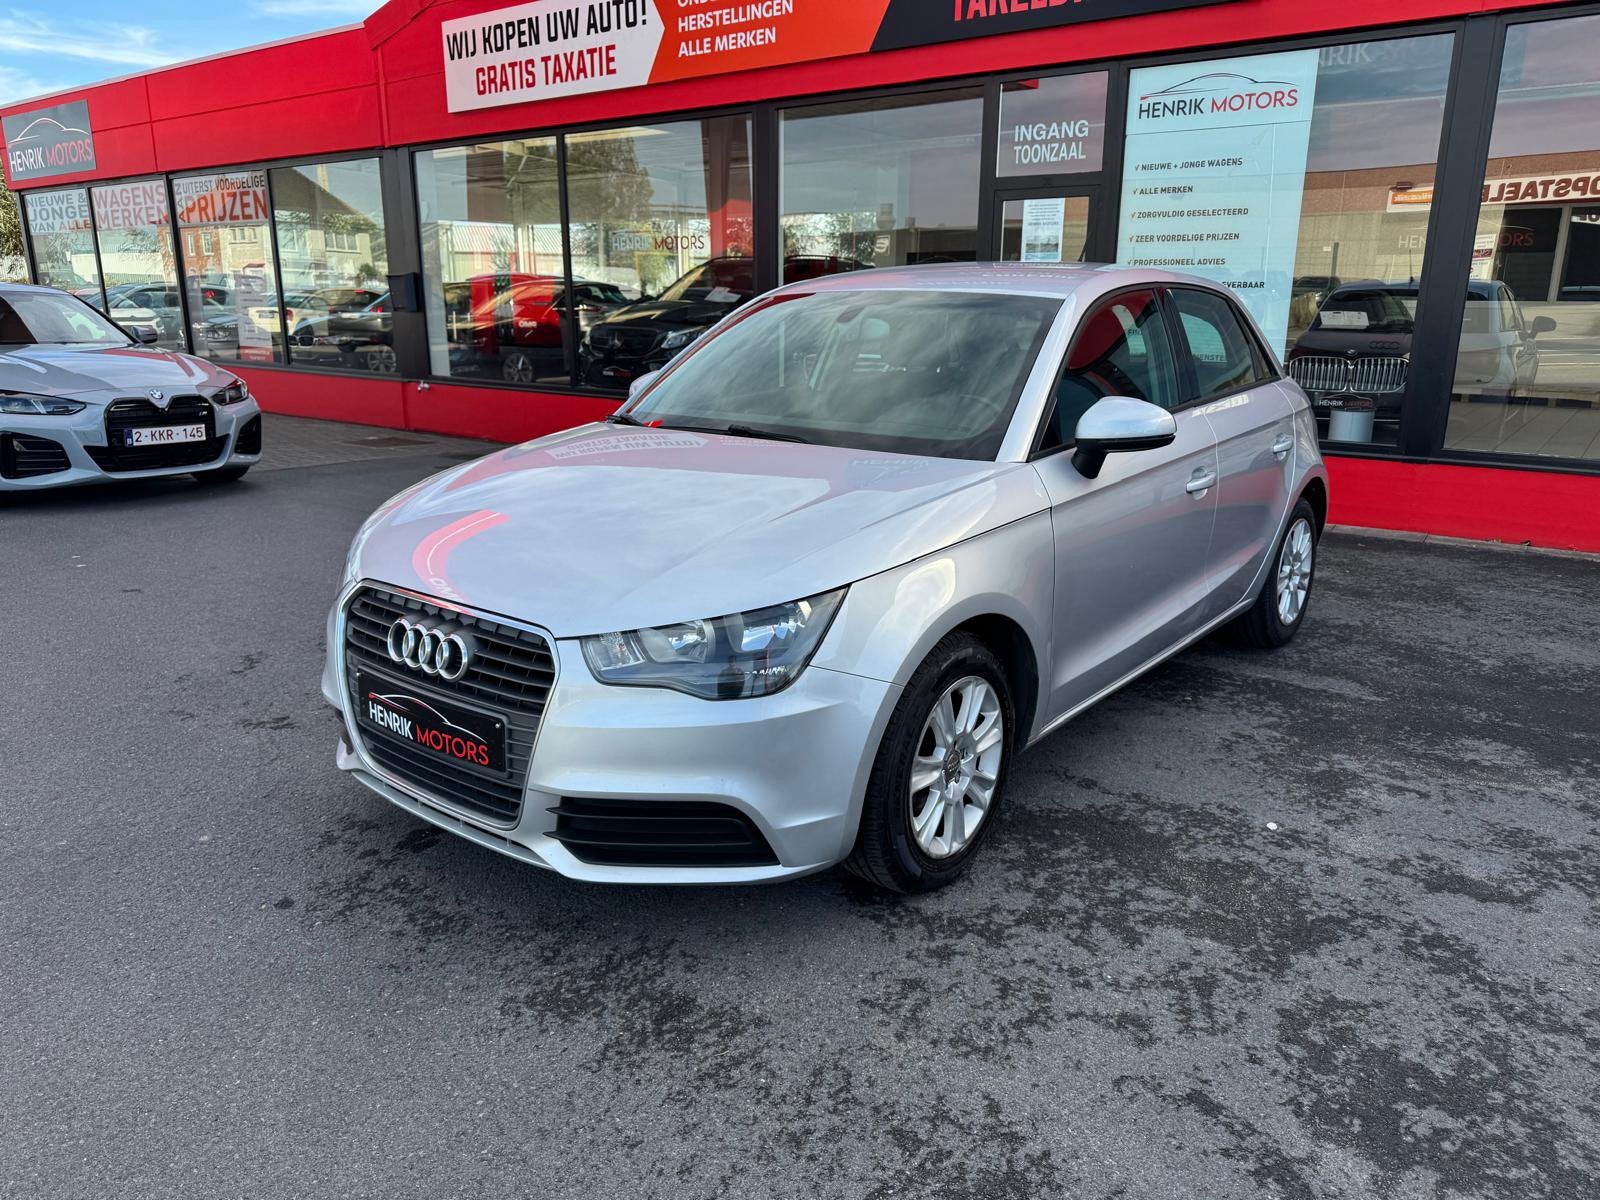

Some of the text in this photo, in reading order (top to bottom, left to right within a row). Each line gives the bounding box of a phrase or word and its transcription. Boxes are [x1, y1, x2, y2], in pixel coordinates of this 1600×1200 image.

[678, 0, 794, 32] HERSTELLINGEN
[446, 0, 647, 61] WIJ KOPEN UW AUTO!
[678, 26, 777, 58] ALLE MERKEN
[475, 44, 616, 96] GRATIS TAXATIE
[1138, 88, 1299, 120] HENRIK MOTORS
[1014, 119, 1089, 142] INGANG
[8, 138, 93, 173] HENRIK MOTORS
[1013, 141, 1086, 165] TOONZAAL
[1141, 162, 1172, 171] NIEUWE
[1179, 160, 1206, 169] JONGE
[1207, 157, 1243, 167] WAGENS
[182, 174, 265, 194] UITERST VOORDELIGE
[1139, 185, 1194, 195] ALLE MERKEN
[26, 192, 86, 208] NIEUWE &
[94, 184, 165, 209] WAGENS
[184, 189, 269, 223] PRIJZEN
[30, 204, 88, 222] JONGE
[1137, 208, 1249, 219] ZORGVULDIG GESELECTEERD
[31, 218, 92, 232] VAN ALLE
[654, 234, 705, 250] MOTORS
[1135, 232, 1240, 243] ZEER VOORDELIGE PRIJZEN
[1133, 258, 1226, 267] PROFESSIONEEL ADVIES
[368, 701, 489, 766] HENRIK MOTORS
